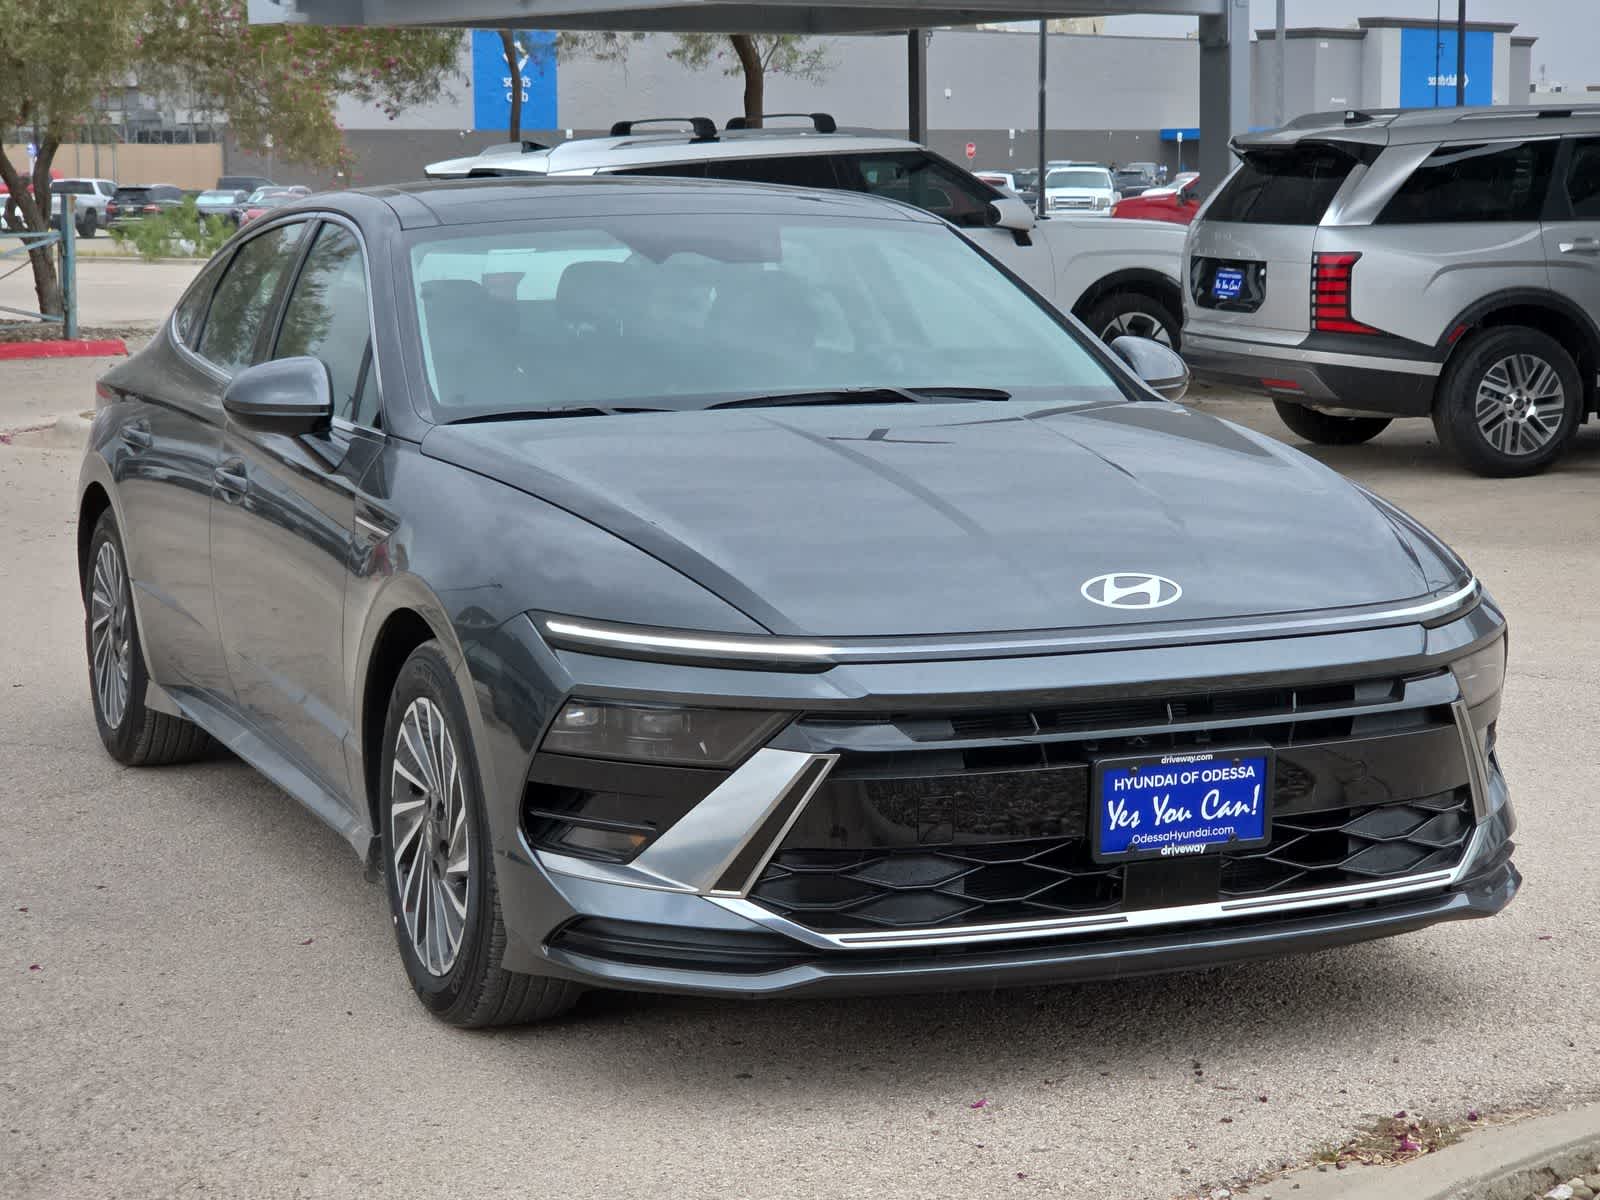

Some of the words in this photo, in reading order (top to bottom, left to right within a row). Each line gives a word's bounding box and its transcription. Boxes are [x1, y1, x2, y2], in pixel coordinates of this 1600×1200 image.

[506, 88, 529, 102] cb
[1161, 753, 1213, 765] driveway.com
[1114, 773, 1177, 791] HYUNDAI
[1180, 772, 1199, 785] OF
[1202, 766, 1256, 782] ODESSA
[1107, 798, 1141, 831] Yes
[1153, 794, 1193, 826] You
[1201, 784, 1261, 821] Can!
[1132, 826, 1235, 844] OdessaHyundai.com
[1160, 842, 1207, 857] driveway
